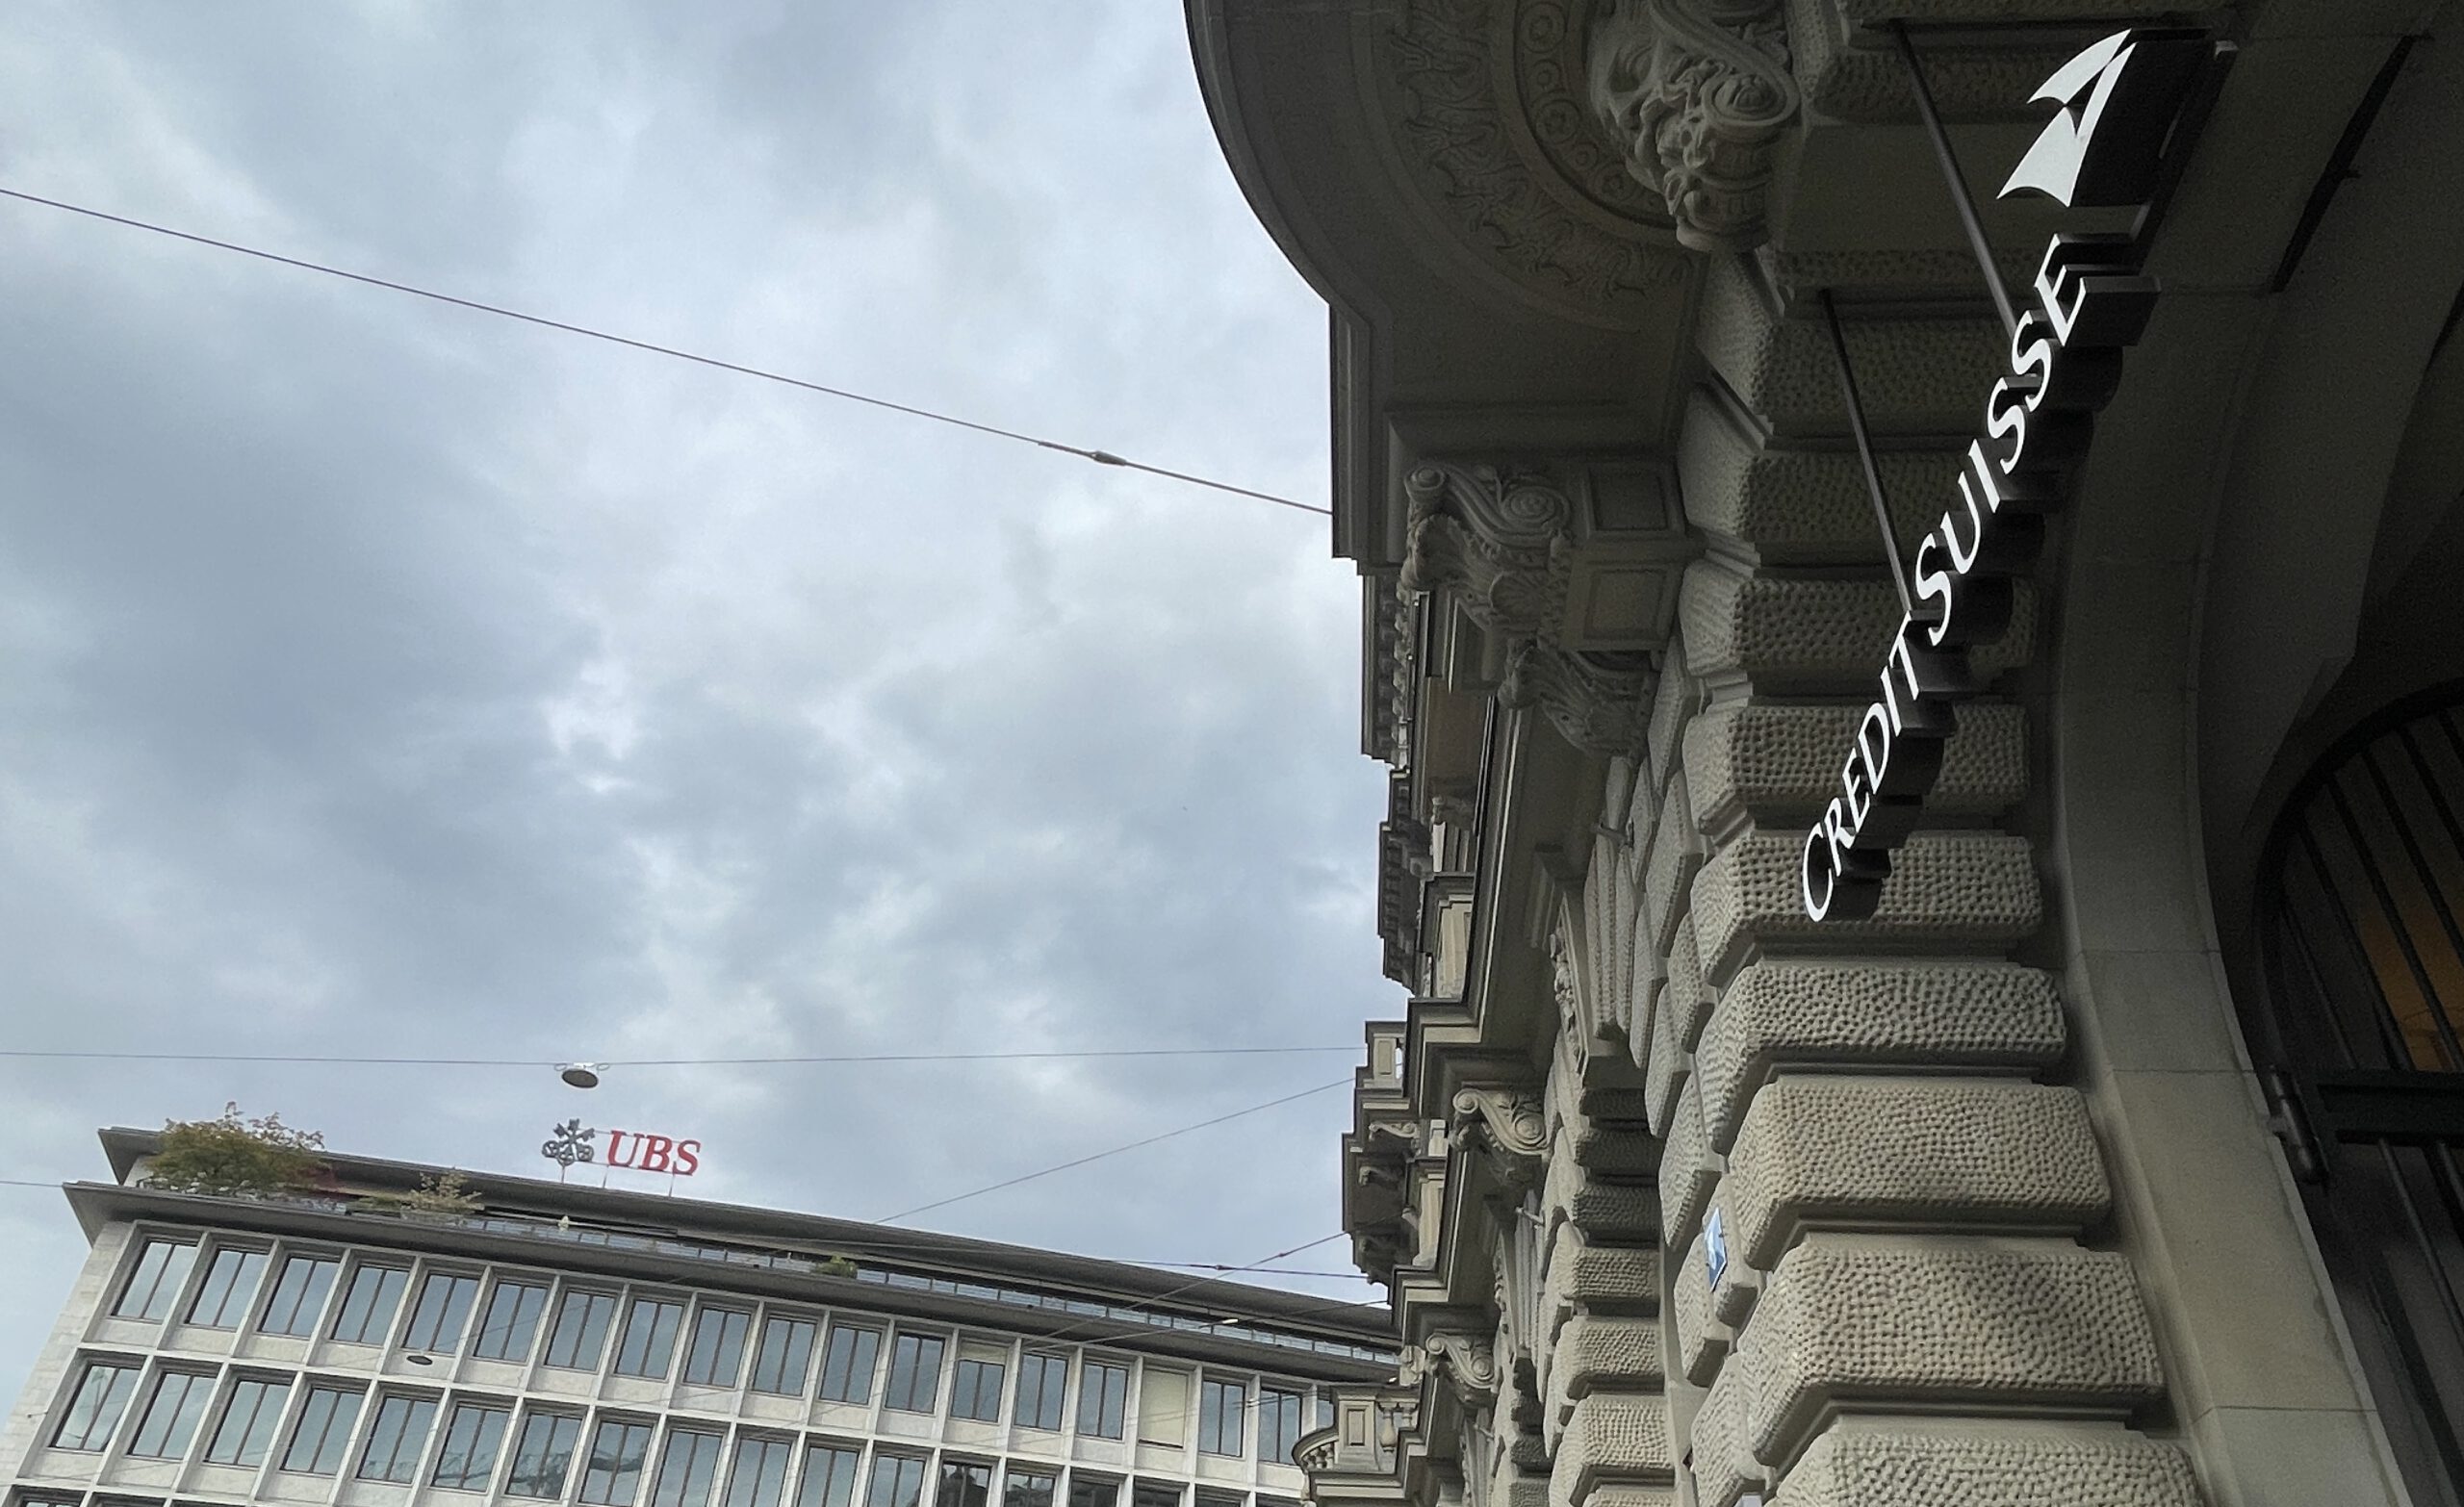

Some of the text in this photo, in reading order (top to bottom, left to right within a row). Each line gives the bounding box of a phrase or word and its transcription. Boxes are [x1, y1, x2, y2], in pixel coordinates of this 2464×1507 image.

[1802, 234, 2087, 922] CREDIT SUISSE
[607, 1130, 701, 1176] UBS
